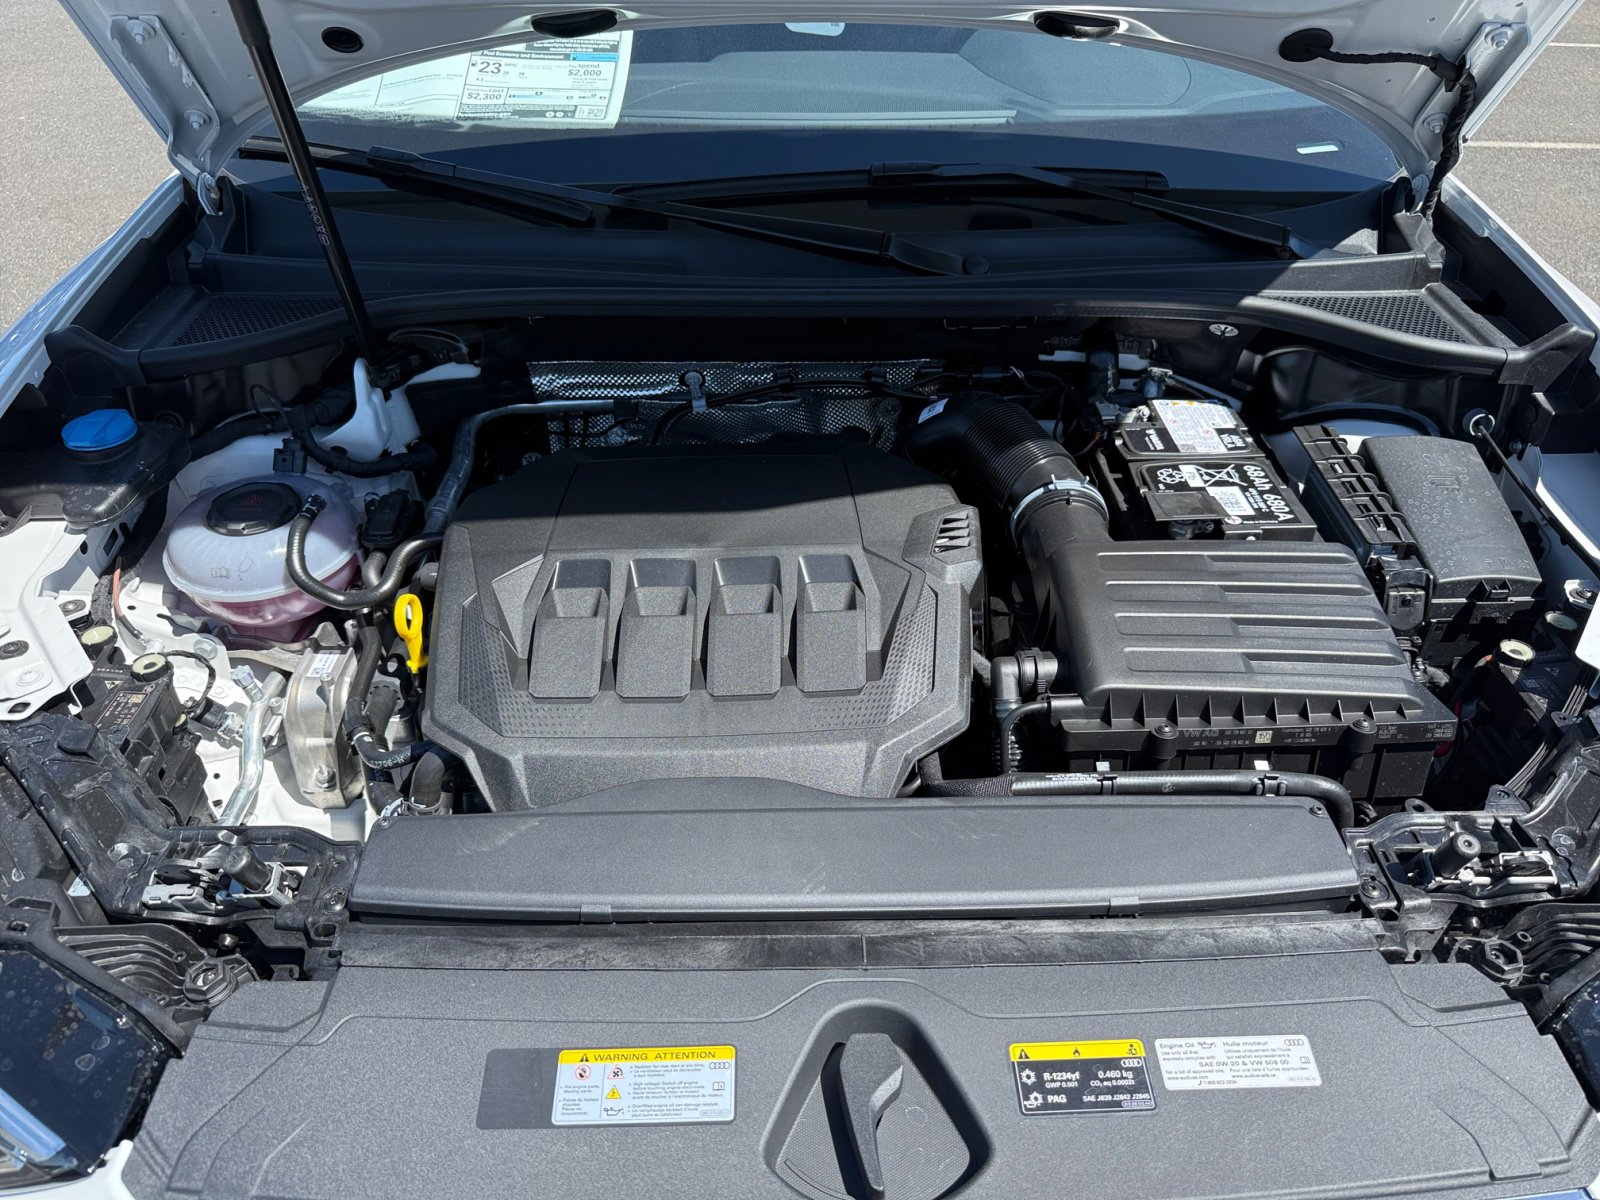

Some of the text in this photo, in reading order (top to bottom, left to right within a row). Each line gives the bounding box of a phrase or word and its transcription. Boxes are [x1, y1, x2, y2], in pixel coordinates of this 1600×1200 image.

[478, 61, 501, 74] 23
[568, 69, 602, 77] $2,000
[467, 92, 501, 100] $2,300
[1243, 465, 1273, 490] 68Ah
[1262, 494, 1295, 521] 680A
[594, 1051, 716, 1062] WARNING ATTENTION
[1043, 1071, 1080, 1081] R-1234yf
[1098, 1070, 1133, 1079] 0.460 kg
[1047, 1094, 1067, 1103] PAG
